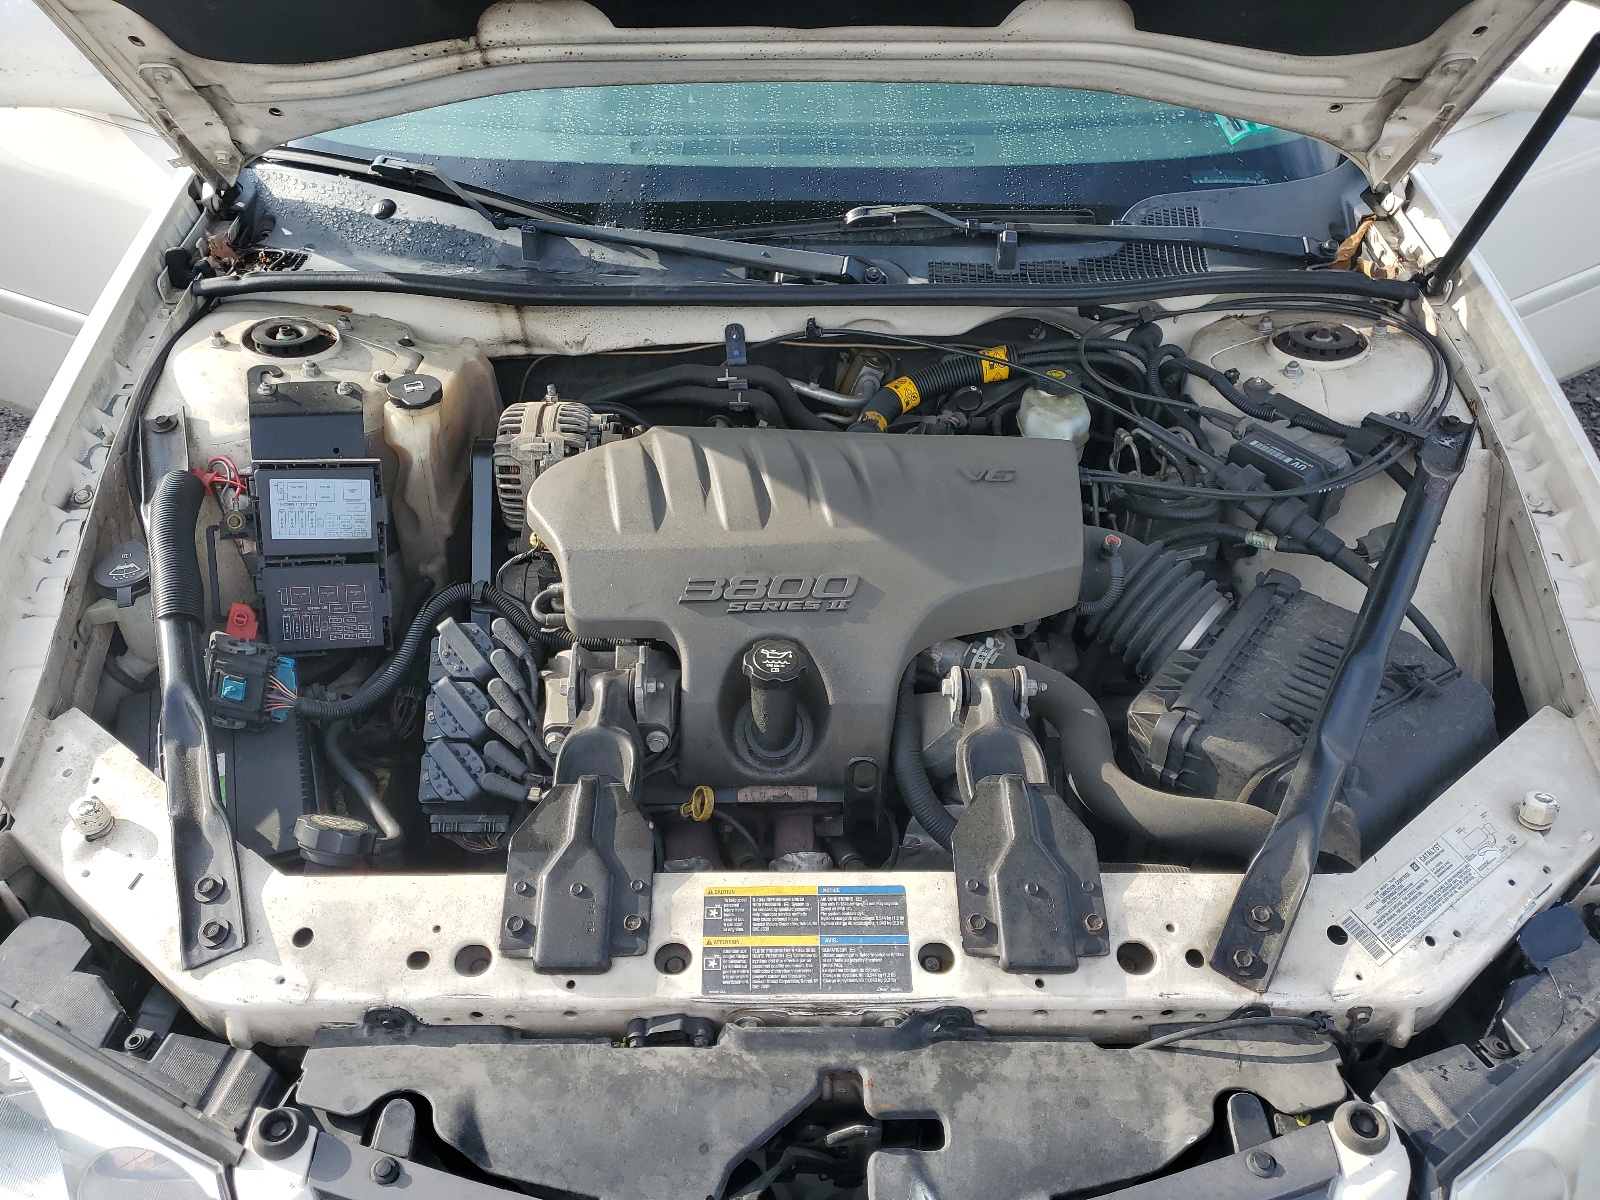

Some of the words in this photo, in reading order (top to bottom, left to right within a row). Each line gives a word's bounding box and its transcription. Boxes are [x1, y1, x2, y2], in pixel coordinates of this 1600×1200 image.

[957, 466, 1016, 483] V6
[679, 573, 859, 604] 3800
[727, 599, 823, 614] SERIES
[1418, 842, 1442, 862] CATALYST
